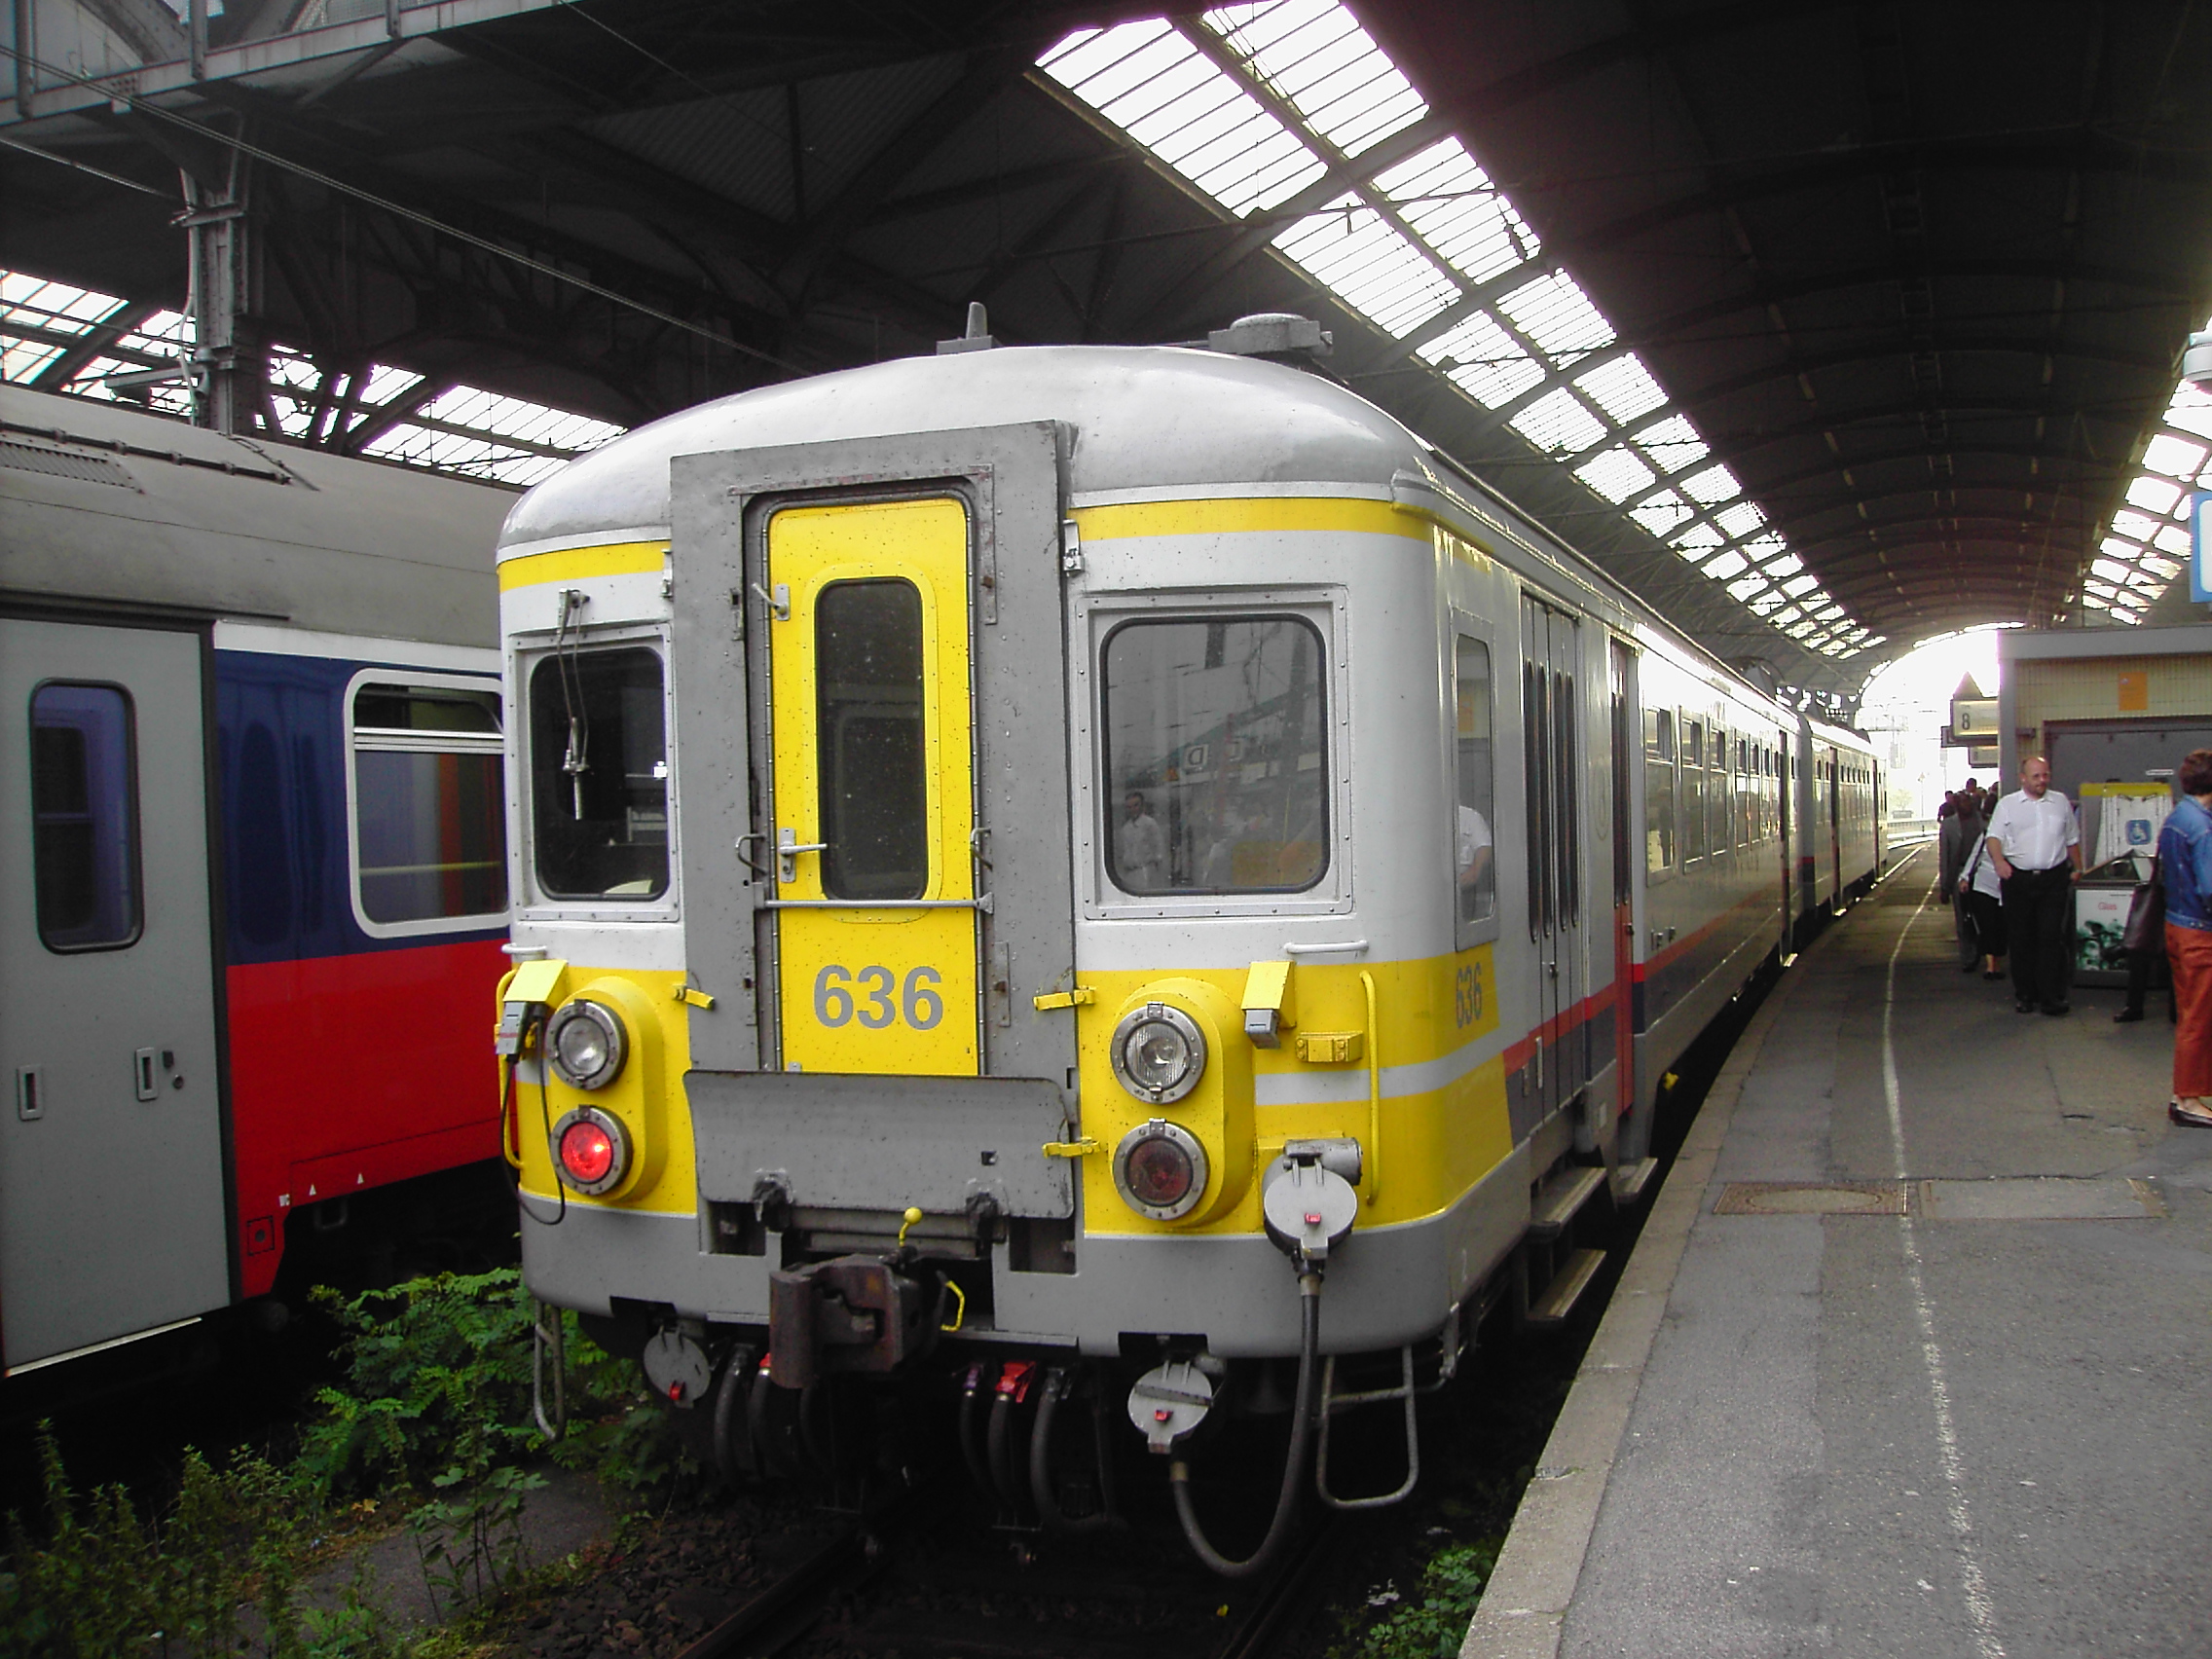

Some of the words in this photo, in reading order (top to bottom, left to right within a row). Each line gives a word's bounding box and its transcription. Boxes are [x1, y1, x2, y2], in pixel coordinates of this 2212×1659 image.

[1962, 713, 1971, 730] 8
[814, 964, 943, 1031] 636
[1456, 962, 1482, 1029] 636
